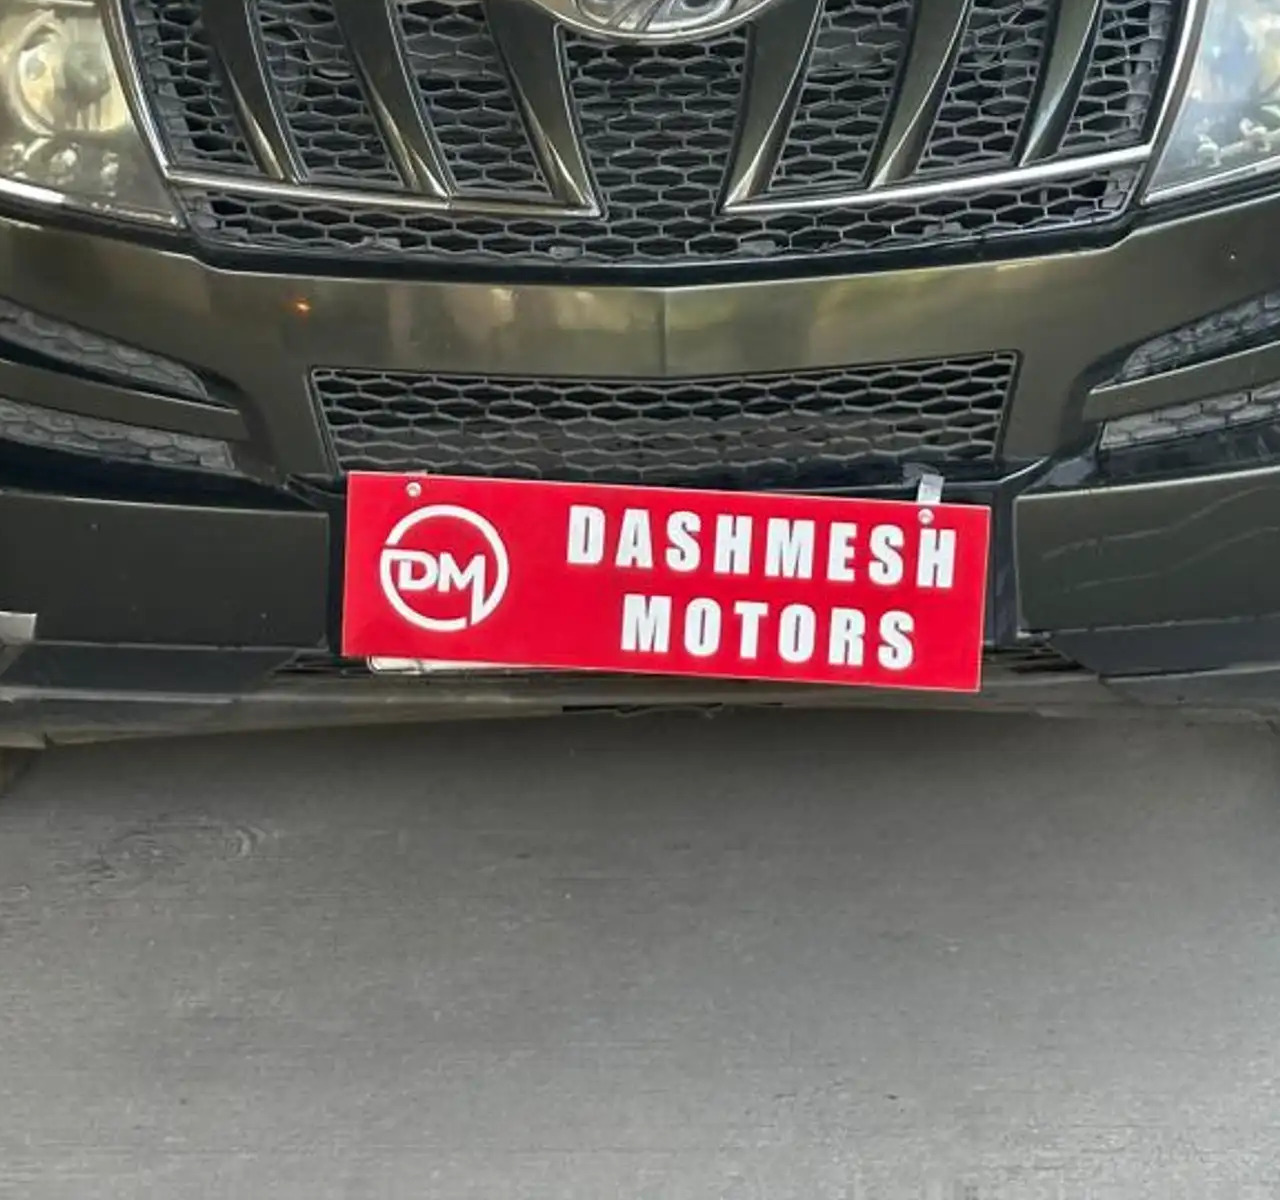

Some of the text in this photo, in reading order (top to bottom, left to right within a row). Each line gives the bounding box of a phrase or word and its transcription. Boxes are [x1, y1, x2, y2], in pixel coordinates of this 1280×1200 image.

[566, 504, 956, 588] DASHMESH
[396, 551, 486, 618] DM
[621, 594, 914, 670] MOTORS
